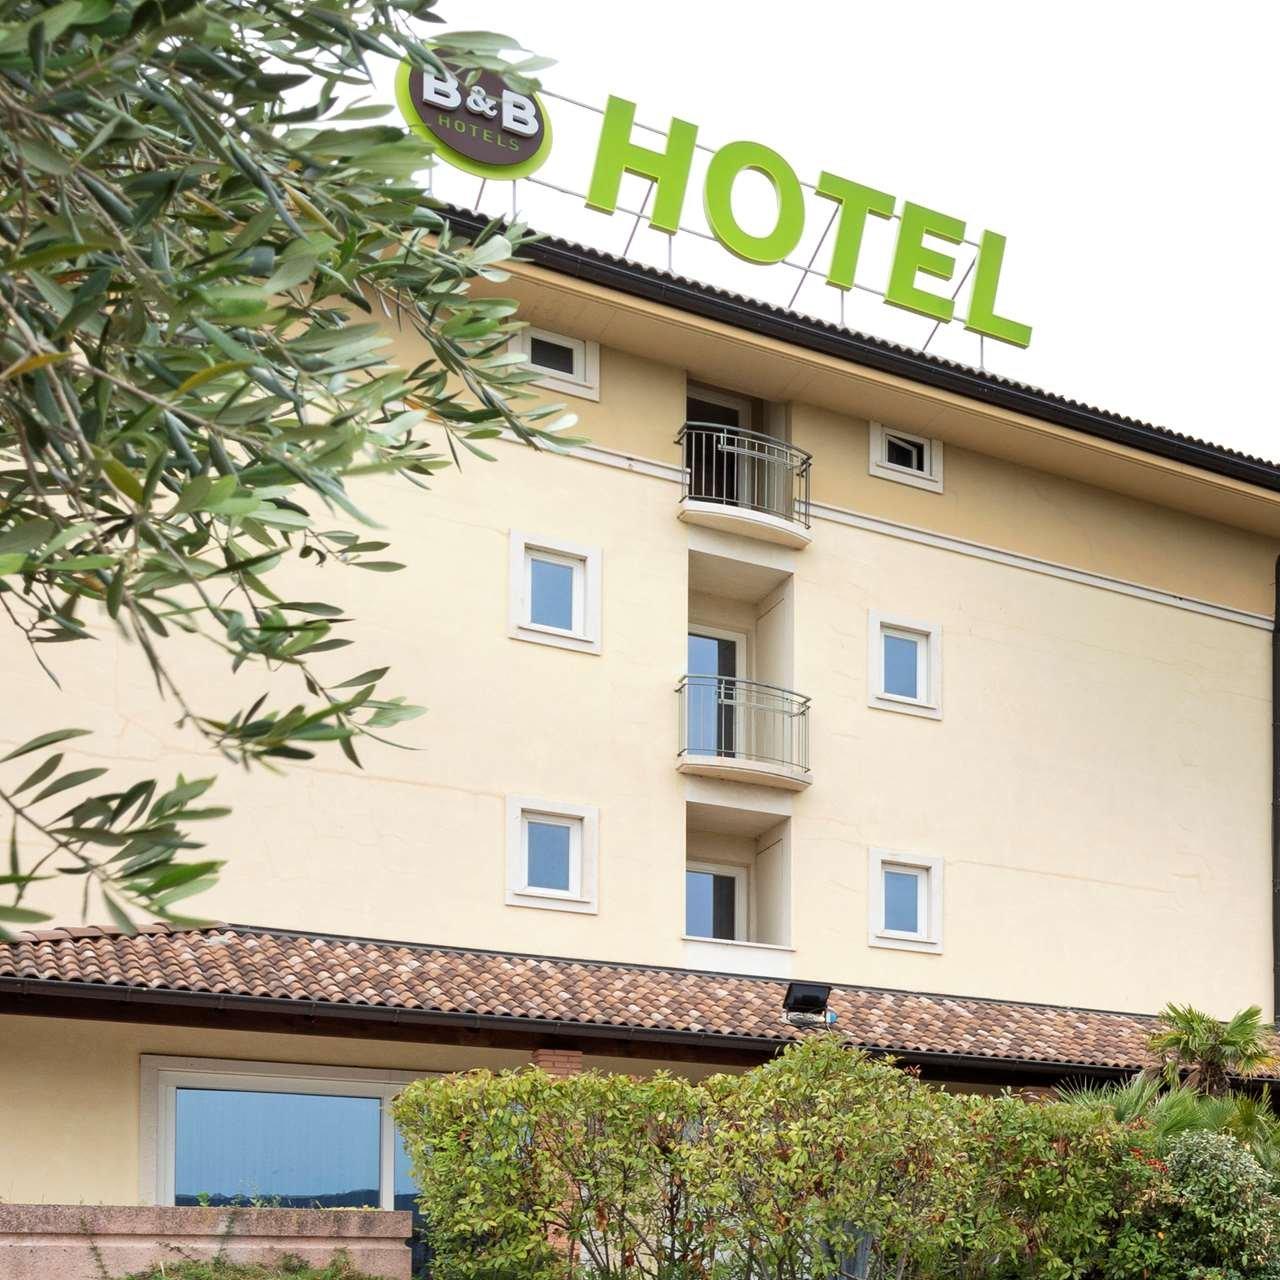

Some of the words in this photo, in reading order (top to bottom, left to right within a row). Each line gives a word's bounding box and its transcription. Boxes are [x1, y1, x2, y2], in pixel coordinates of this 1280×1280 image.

[423, 64, 539, 138] B&B
[429, 114, 520, 151] HOTELS
[584, 94, 1033, 350] HOTEL
